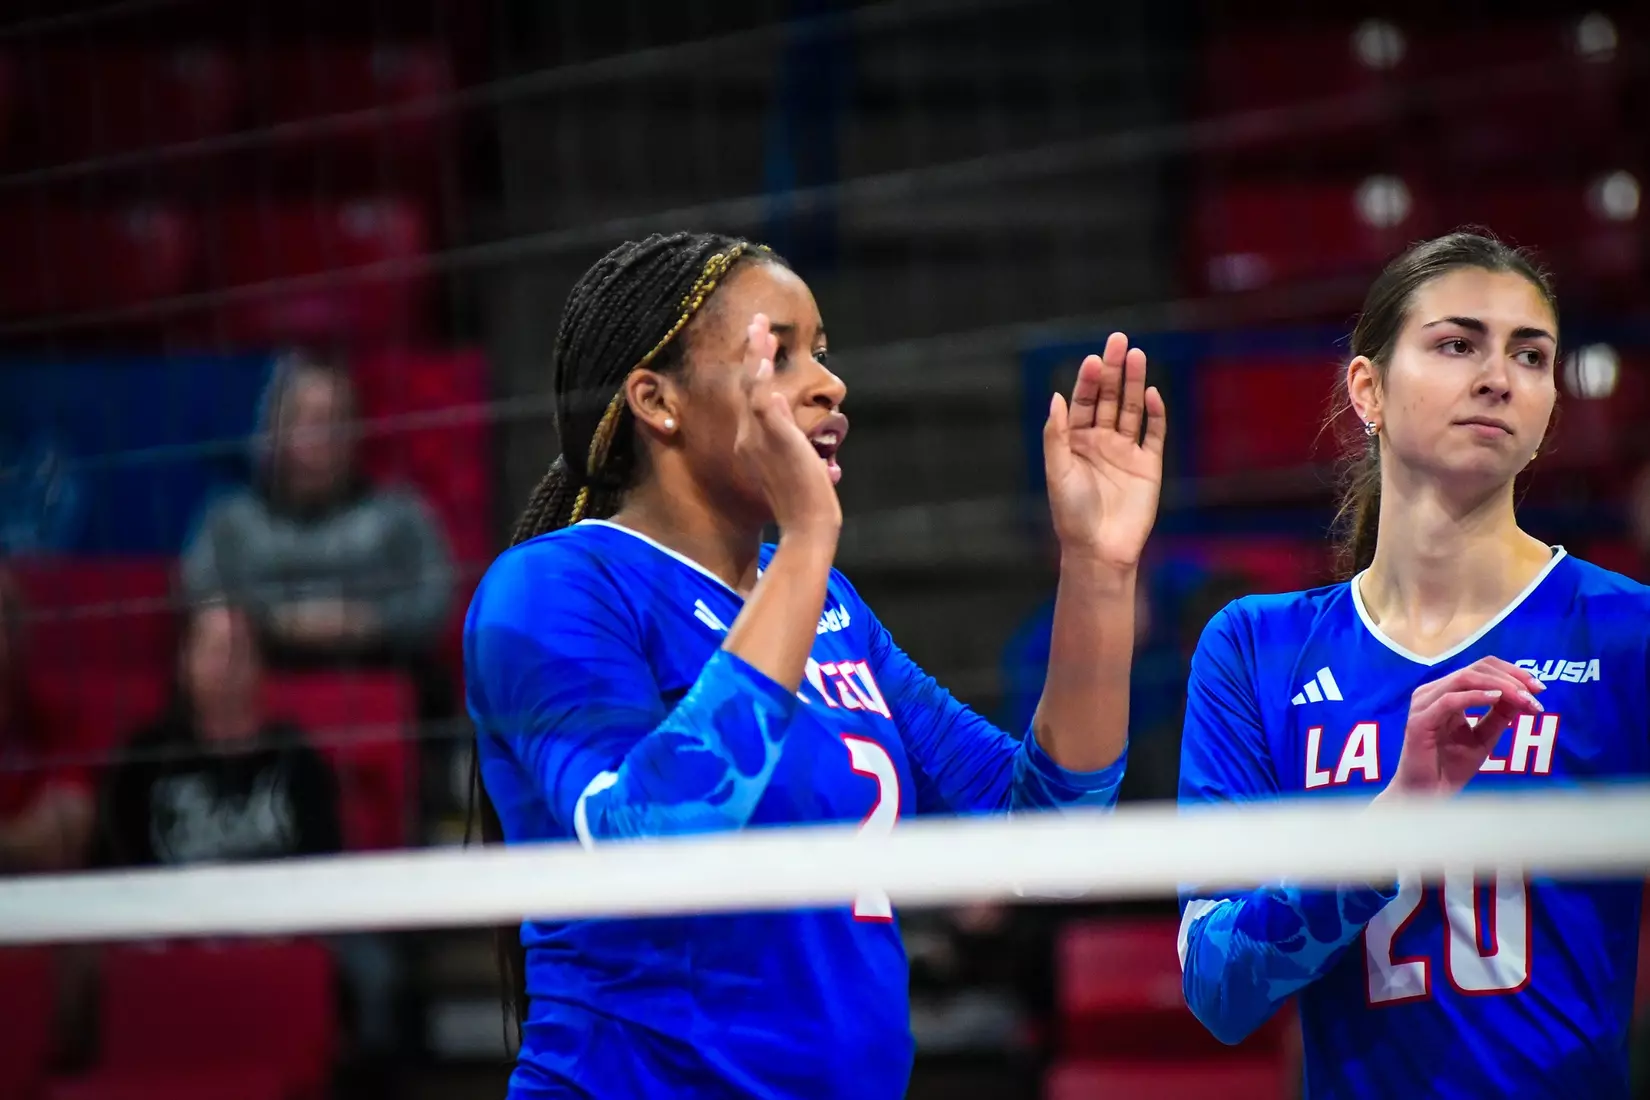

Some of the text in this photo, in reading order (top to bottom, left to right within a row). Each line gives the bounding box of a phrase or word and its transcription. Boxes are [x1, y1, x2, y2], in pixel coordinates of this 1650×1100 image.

[1304, 721, 1381, 789] LA
[840, 732, 901, 923] 2
[1364, 868, 1533, 1008] 20
